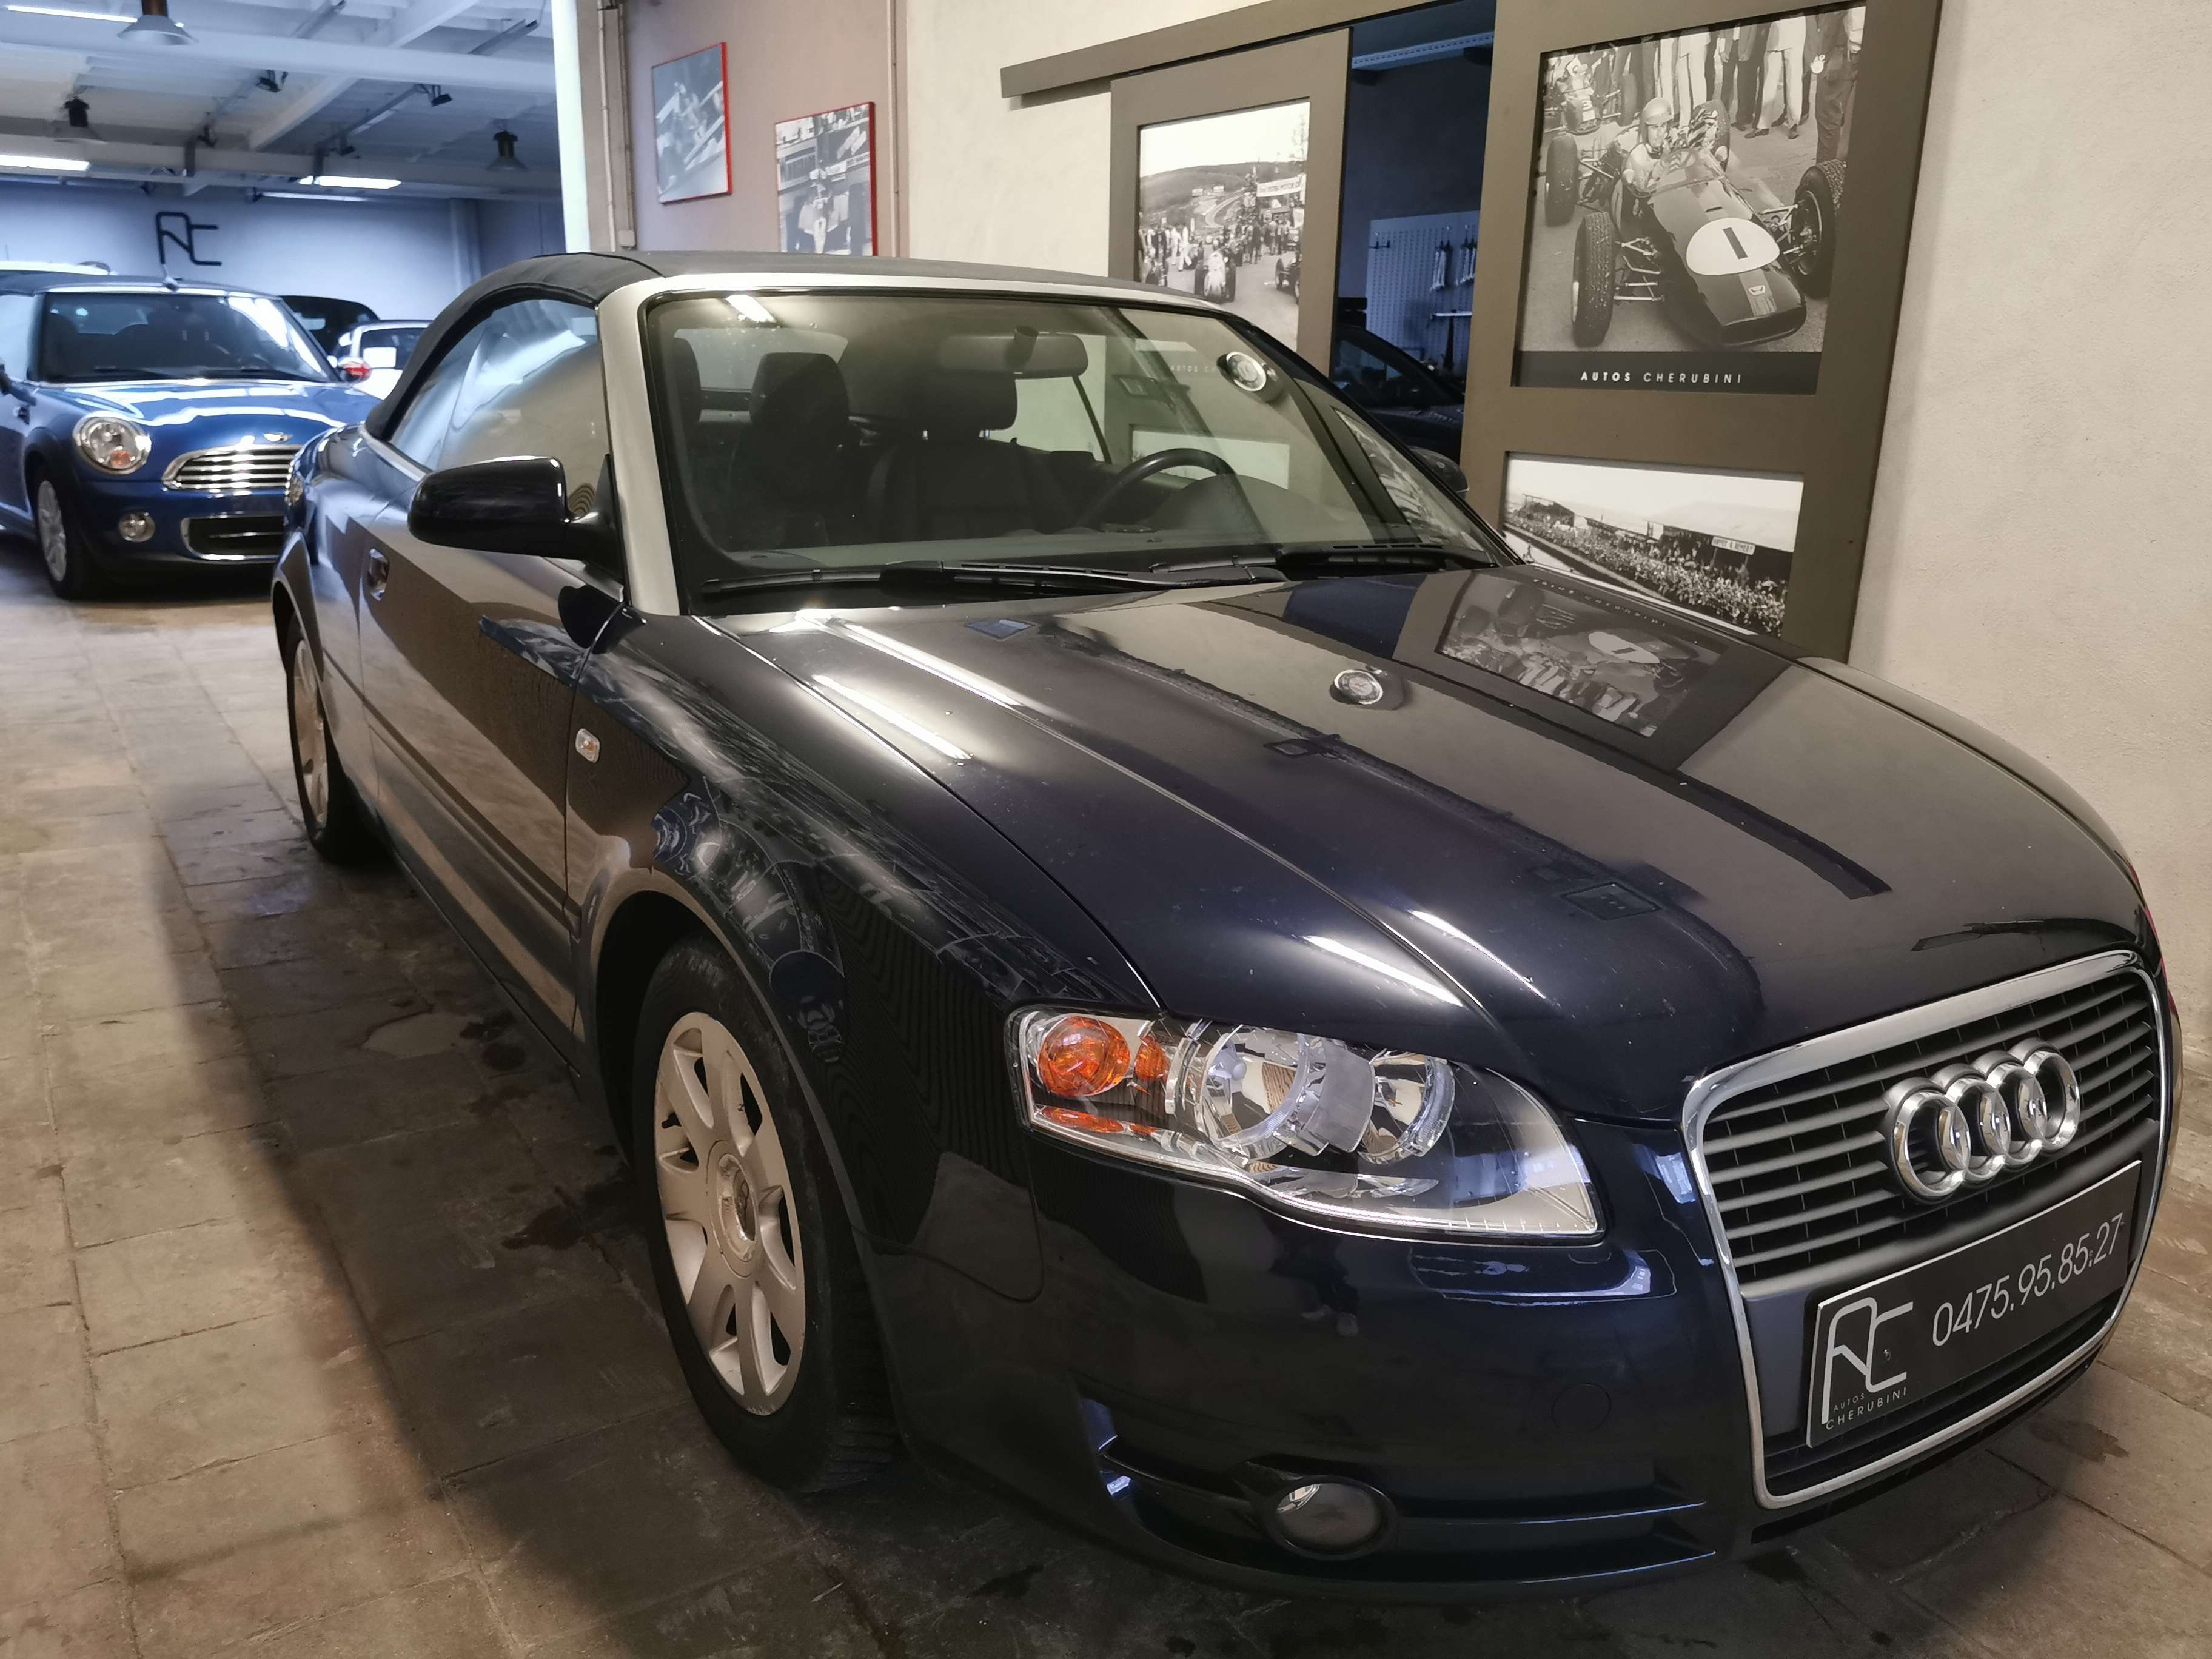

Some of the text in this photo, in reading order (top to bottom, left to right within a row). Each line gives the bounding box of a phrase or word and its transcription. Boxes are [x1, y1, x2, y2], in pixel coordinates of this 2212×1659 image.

[1722, 227, 1749, 260] 1
[1580, 371, 1741, 384] AUTOS CHERUBINI
[1932, 1212, 2123, 1346] 0475.95.85.27
[1826, 1387, 1907, 1430] CHERUBINI
[1833, 1392, 1866, 1412] AUTOS
